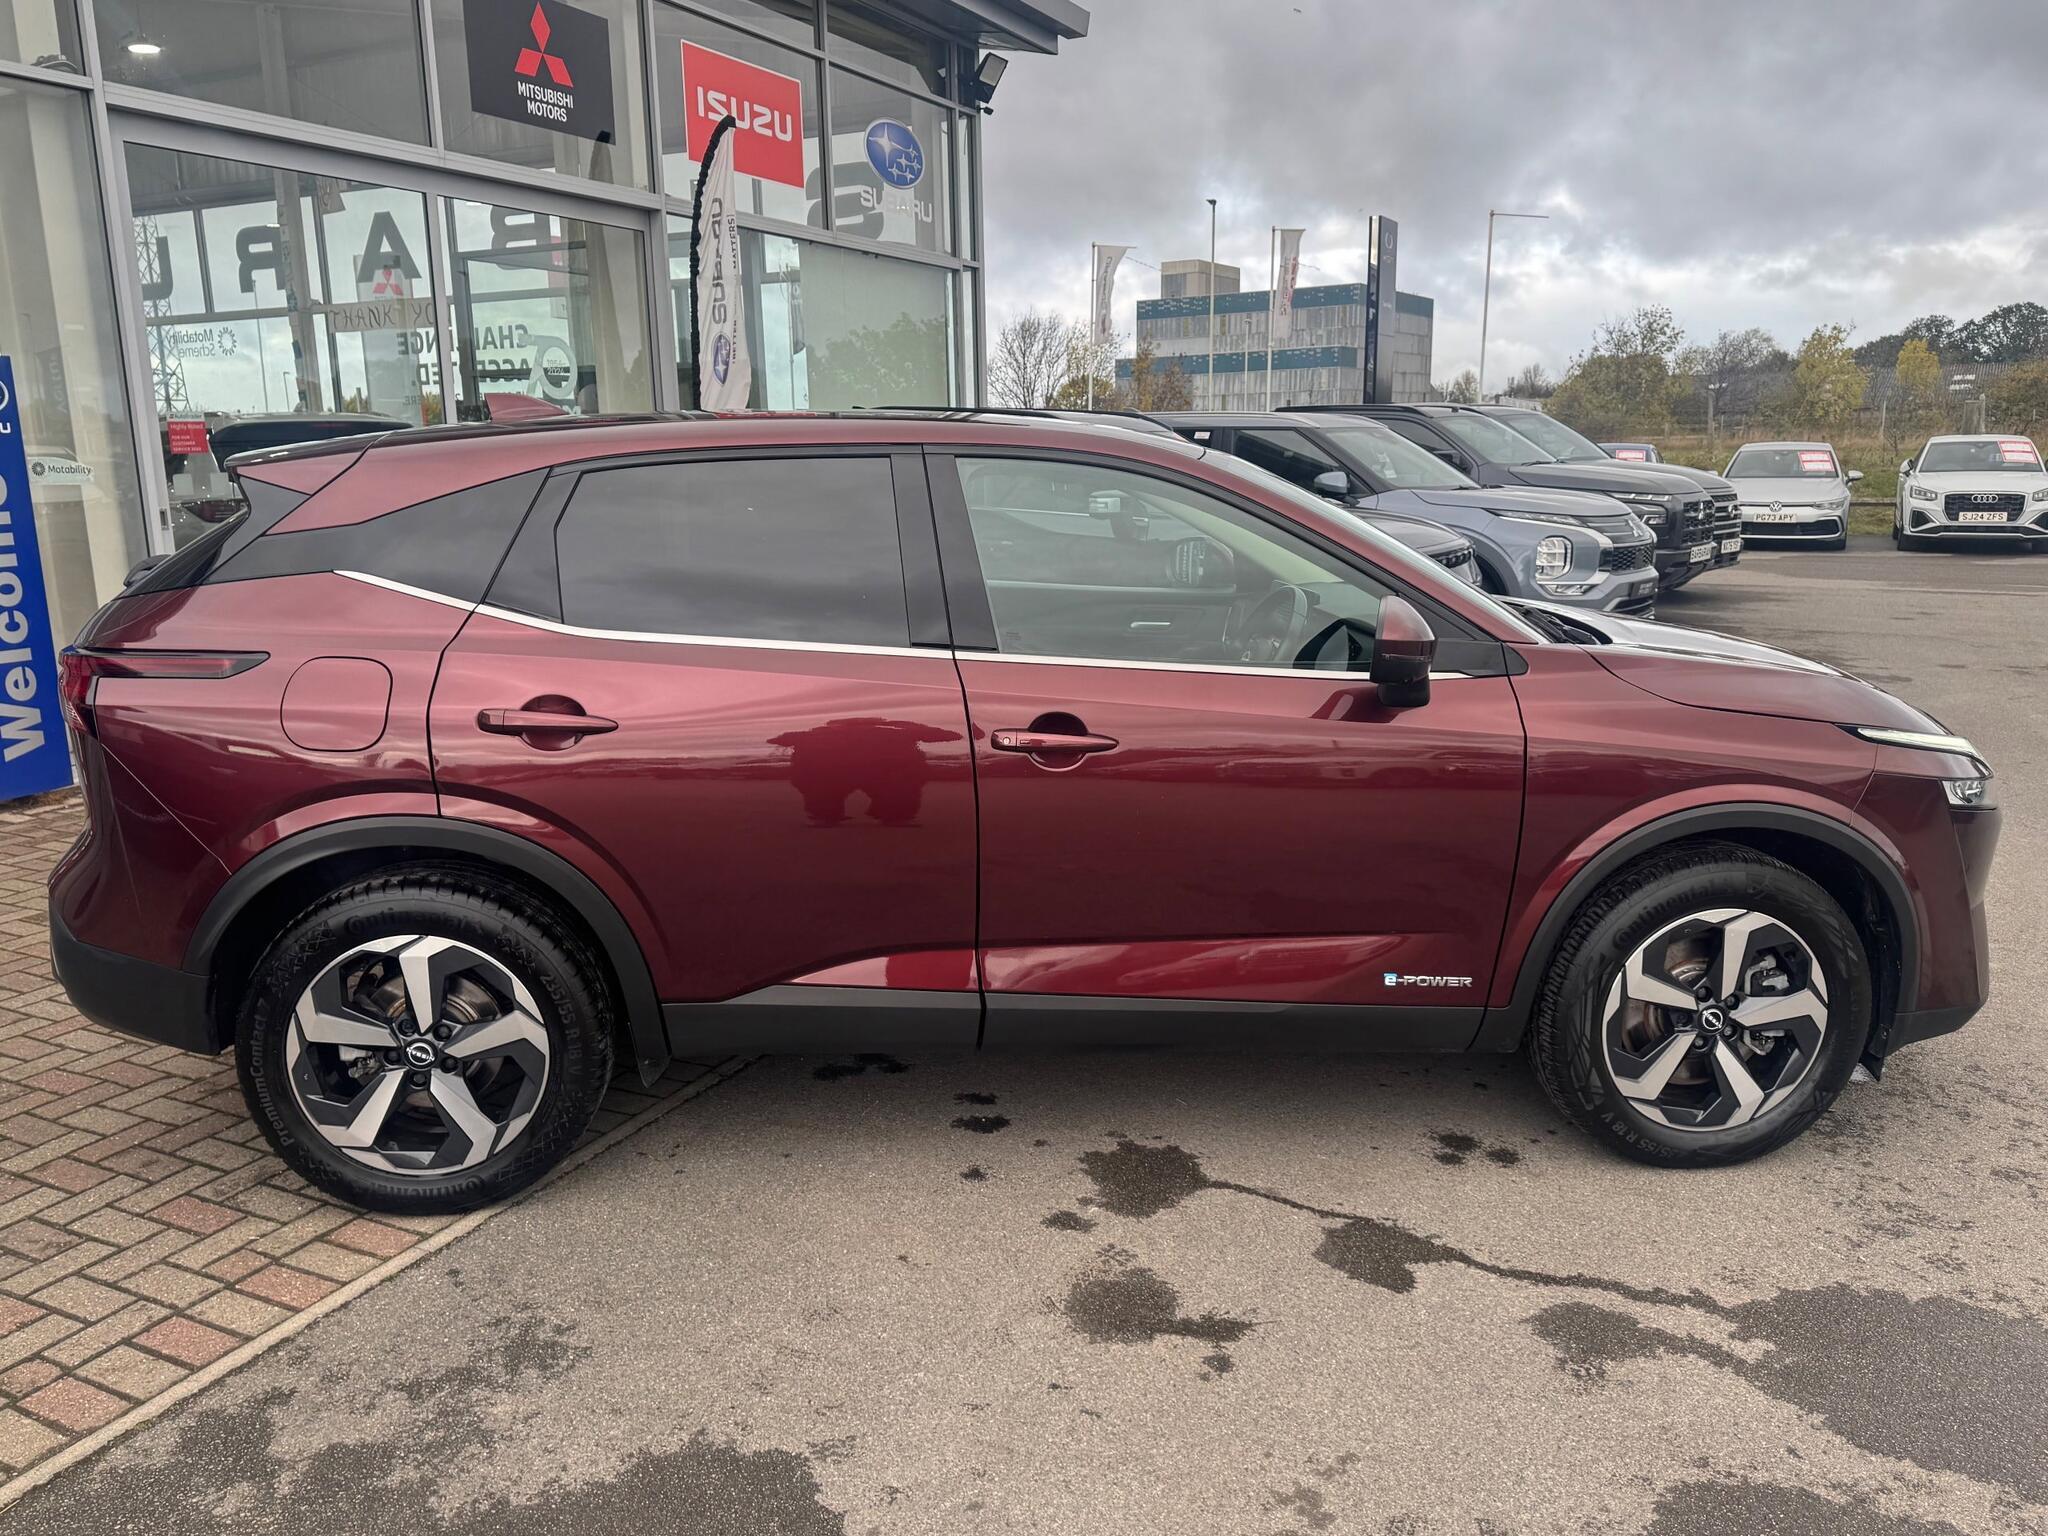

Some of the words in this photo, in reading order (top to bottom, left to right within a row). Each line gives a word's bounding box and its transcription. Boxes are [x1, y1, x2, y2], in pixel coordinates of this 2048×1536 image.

[517, 81, 574, 109] MITSUBISHI
[527, 100, 567, 122] MOTORS
[697, 86, 792, 141] ISUZU
[329, 303, 396, 330] THANK
[47, 464, 92, 476] Motability
[1755, 513, 1776, 521] PG73
[1777, 513, 1794, 521] APY
[1962, 512, 1984, 521] SJ24
[1986, 512, 2004, 521] ZFS
[0, 473, 46, 763] Welco
[1384, 973, 1472, 987] e-POWER
[539, 974, 577, 1025] 235/55
[249, 1013, 295, 1147] PremiumContact
